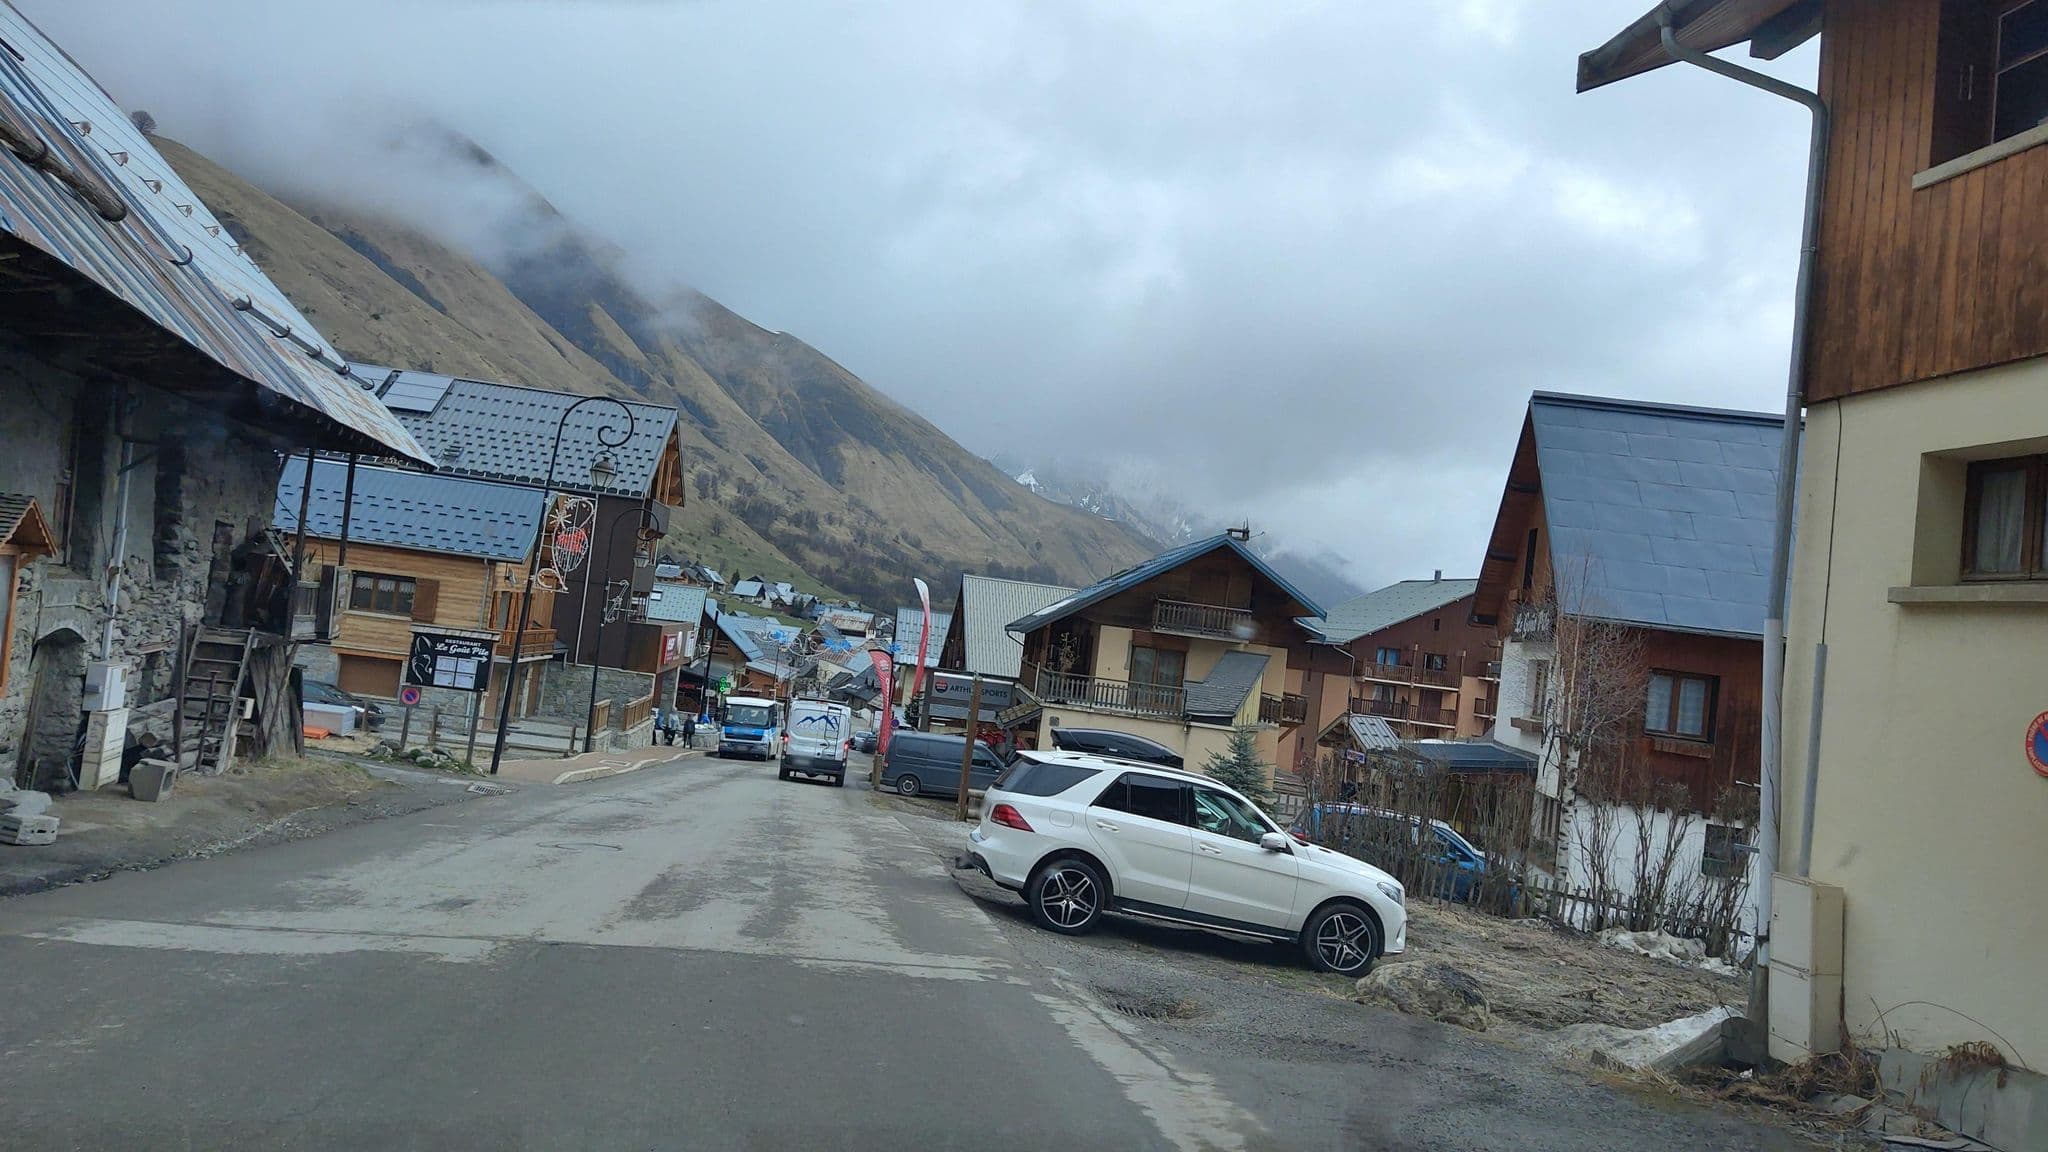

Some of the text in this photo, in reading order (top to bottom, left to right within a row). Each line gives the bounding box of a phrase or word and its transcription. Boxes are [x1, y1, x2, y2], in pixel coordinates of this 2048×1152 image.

[435, 642, 449, 651] Le
[445, 638, 482, 647] RESTAURANT
[980, 688, 1008, 698] SPORTS
